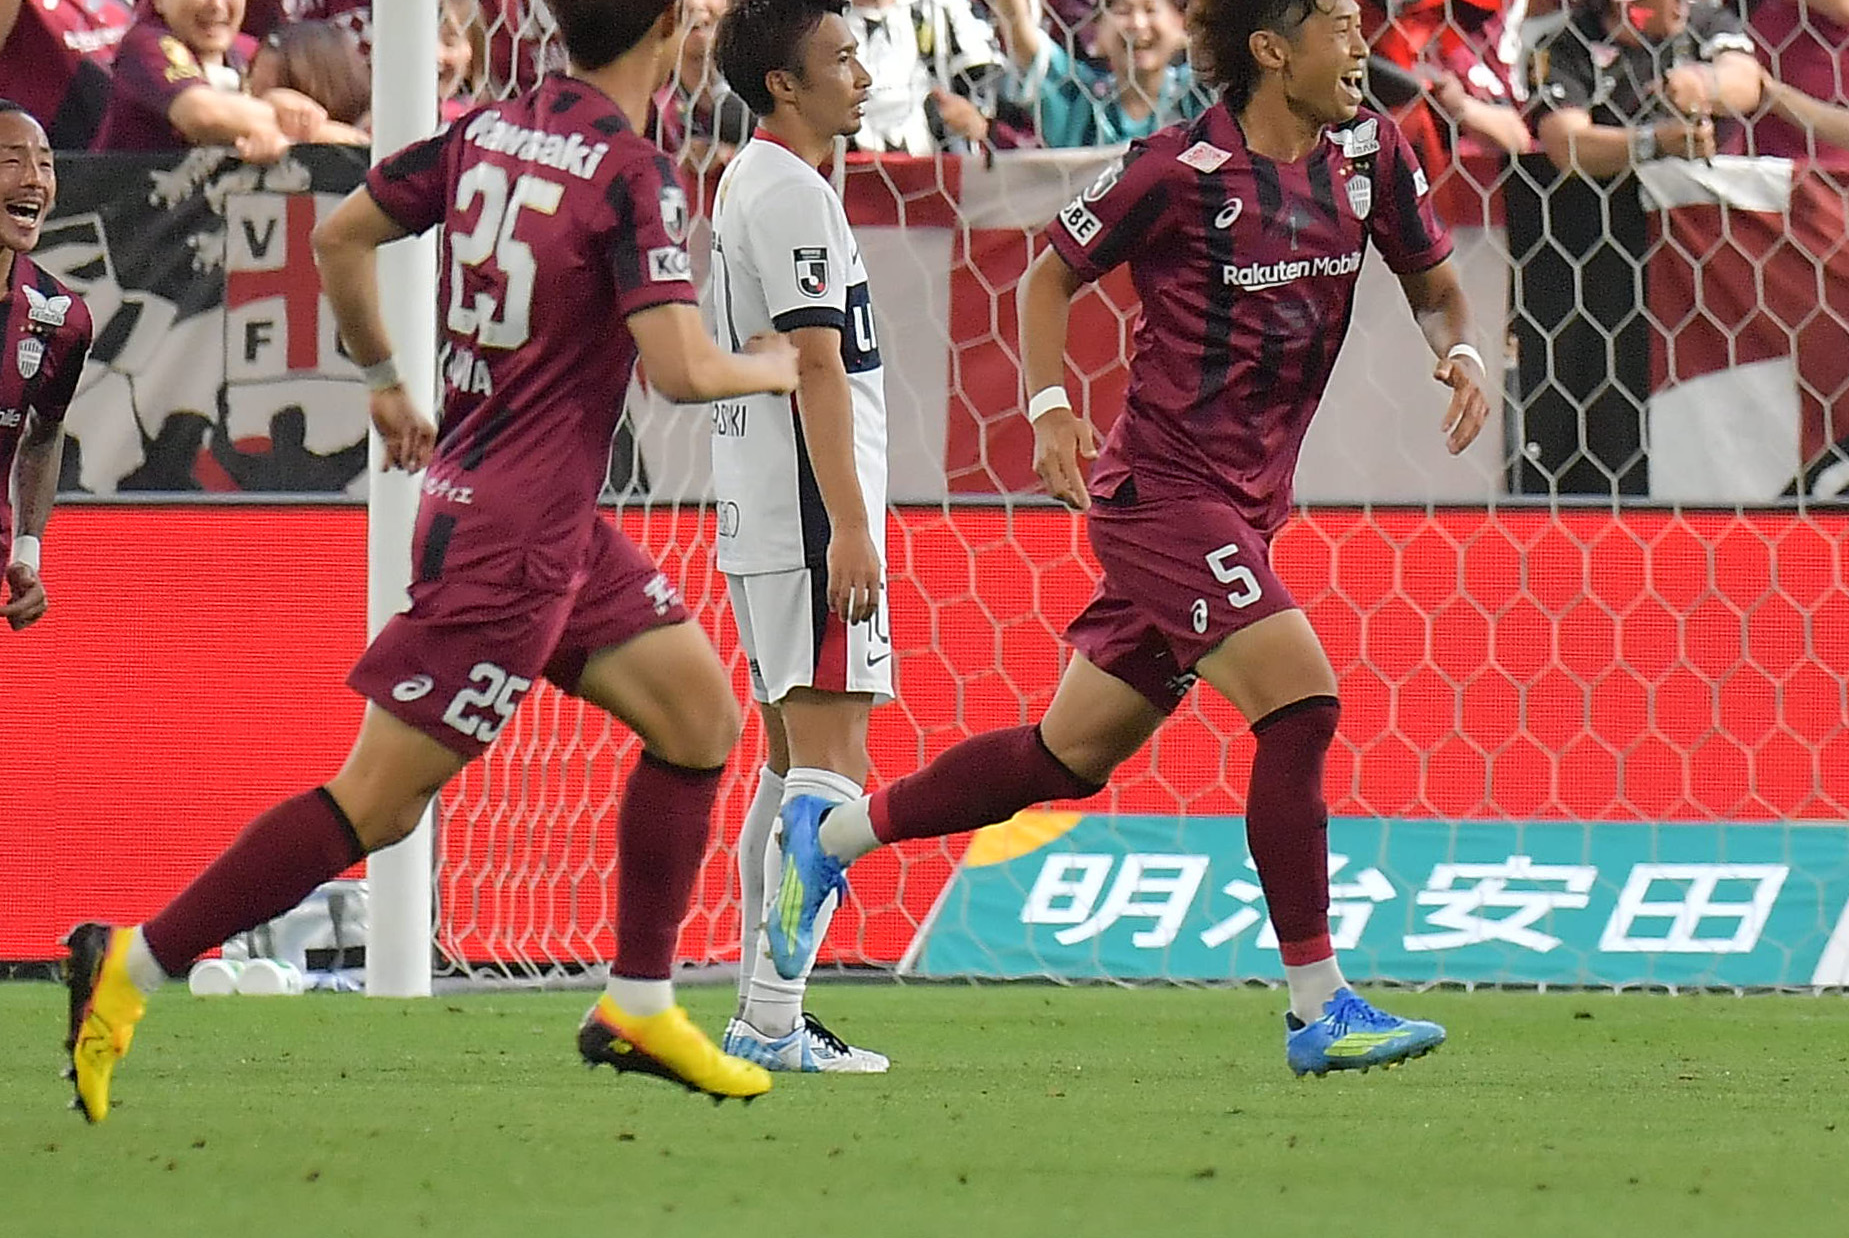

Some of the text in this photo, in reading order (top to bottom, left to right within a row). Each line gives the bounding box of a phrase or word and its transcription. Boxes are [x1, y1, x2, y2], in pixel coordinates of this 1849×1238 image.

[242, 218, 277, 260] V
[448, 161, 567, 351] 25
[1222, 259, 1310, 286] Rakuten
[245, 321, 274, 362] F
[1205, 543, 1262, 609] 5
[442, 661, 532, 743] 25
[1021, 853, 1790, 954] 明治安田
